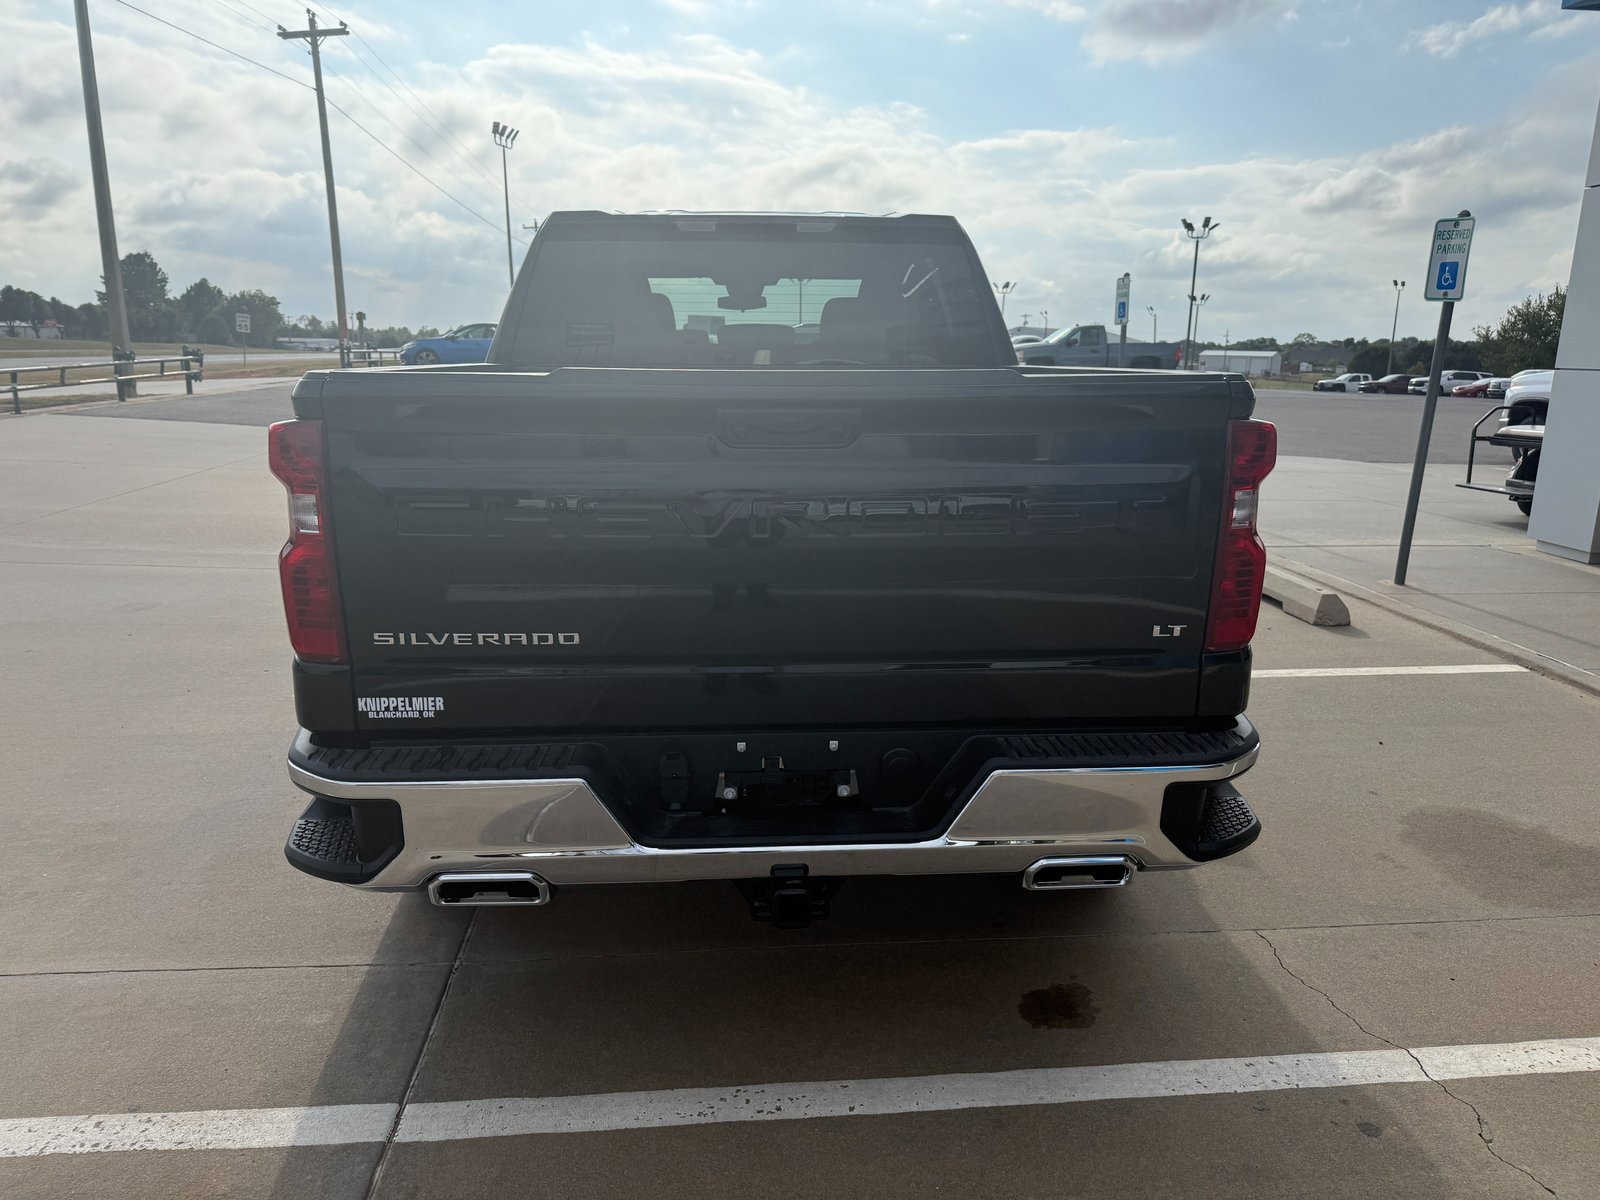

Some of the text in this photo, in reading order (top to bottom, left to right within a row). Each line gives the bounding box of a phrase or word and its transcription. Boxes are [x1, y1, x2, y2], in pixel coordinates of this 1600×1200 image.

[1437, 229, 1470, 240] RESERVED
[1437, 243, 1466, 254] PARKING
[1152, 624, 1188, 637] LT
[373, 632, 580, 645] SILVERADO
[357, 697, 444, 711] KNIPPELMIER
[368, 710, 436, 719] BLANCHARD, OK
